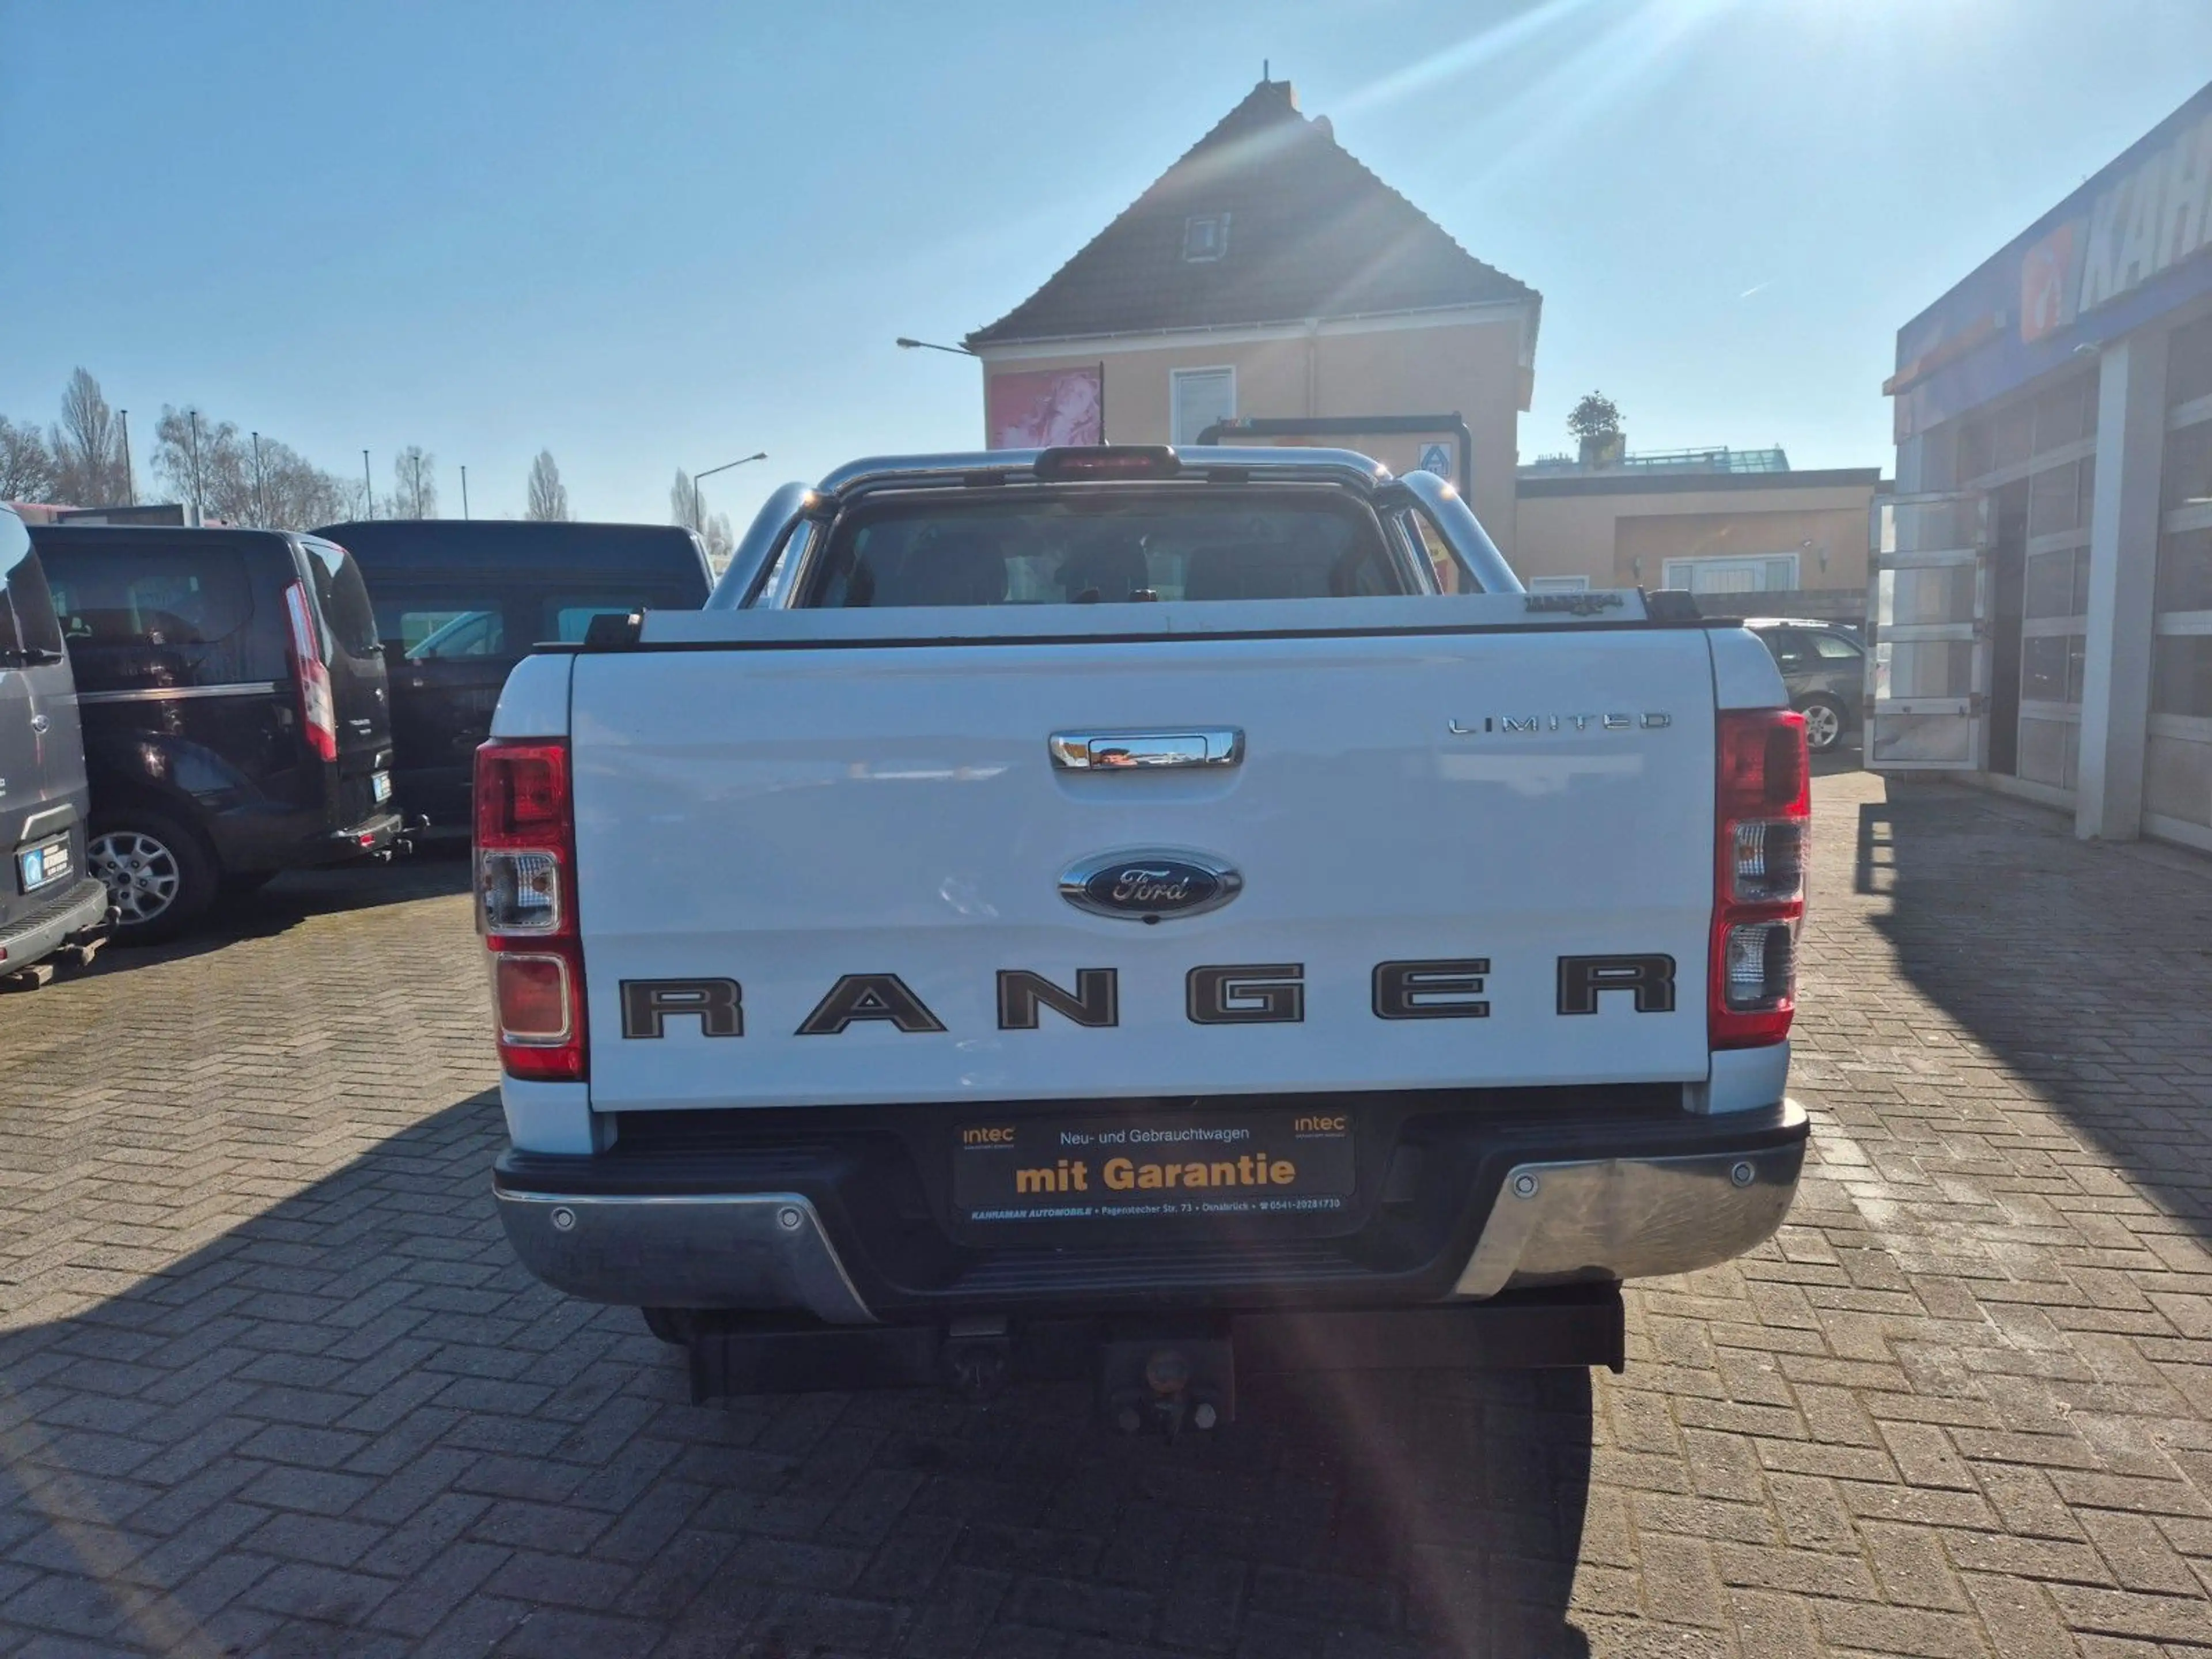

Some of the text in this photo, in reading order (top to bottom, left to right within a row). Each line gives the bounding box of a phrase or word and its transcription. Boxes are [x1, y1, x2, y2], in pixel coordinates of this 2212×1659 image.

[1447, 710, 1672, 734] LIMITED
[1112, 869, 1190, 901] Ford
[618, 953, 1677, 1040] RANGER
[1294, 1116, 1346, 1131] intec
[963, 1127, 1014, 1143] intec
[1060, 1127, 1249, 1145] Neu- und Gebrauchtwagen
[1016, 1153, 1296, 1194] mit Garantie
[1028, 1207, 1093, 1218] AUTOMOBILE
[1181, 1203, 1192, 1213] 73
[1202, 1202, 1248, 1212] Osnabrück
